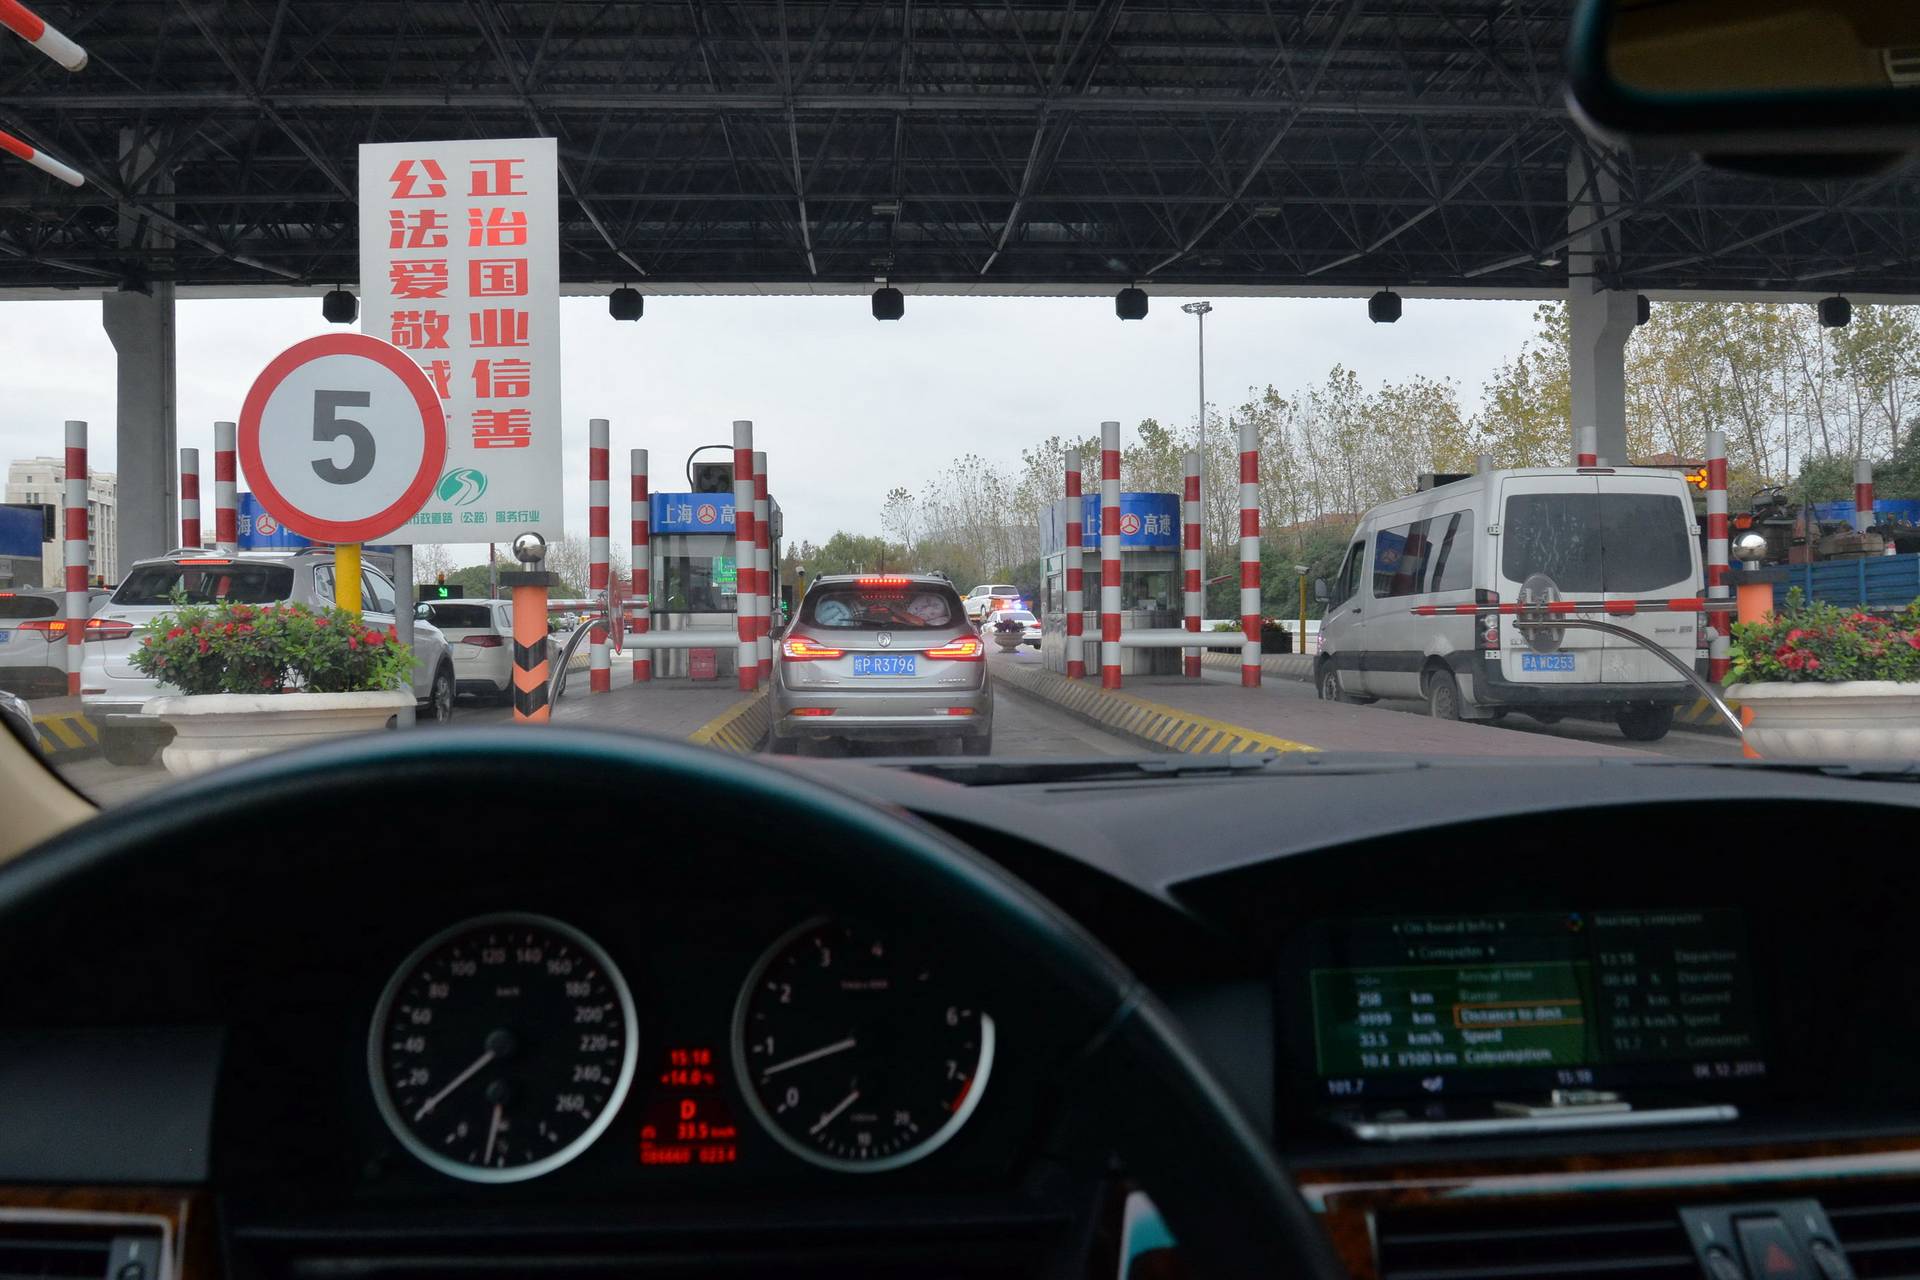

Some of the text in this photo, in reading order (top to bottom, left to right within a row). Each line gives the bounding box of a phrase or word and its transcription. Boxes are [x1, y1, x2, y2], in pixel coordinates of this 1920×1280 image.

[389, 158, 528, 200] 公正
[388, 207, 528, 249] 法治
[388, 257, 529, 299] 爱国
[390, 308, 530, 350] 敬业
[311, 389, 376, 485] 5
[661, 504, 693, 525] 上海
[1082, 513, 1172, 536] 上 高速
[481, 948, 506, 964] 120
[516, 947, 543, 964] 140
[820, 948, 832, 968] 3
[450, 960, 477, 977] 100
[547, 959, 573, 976] 160
[428, 981, 450, 999] 80
[565, 981, 591, 998] 180
[779, 983, 792, 1004] 2
[411, 1007, 433, 1025] 60
[573, 1006, 604, 1024] 200
[945, 1005, 959, 1026] 6
[404, 1036, 426, 1054] 40
[579, 1034, 609, 1052] 220
[765, 1036, 775, 1056] 1
[1462, 1028, 1503, 1045] Speed
[408, 1067, 430, 1086] 20
[572, 1065, 602, 1083] 240
[945, 1060, 959, 1080] 7
[555, 1095, 585, 1113] 260
[785, 1086, 800, 1108] 0
[680, 1099, 697, 1121] D
[857, 1131, 872, 1146] 10
